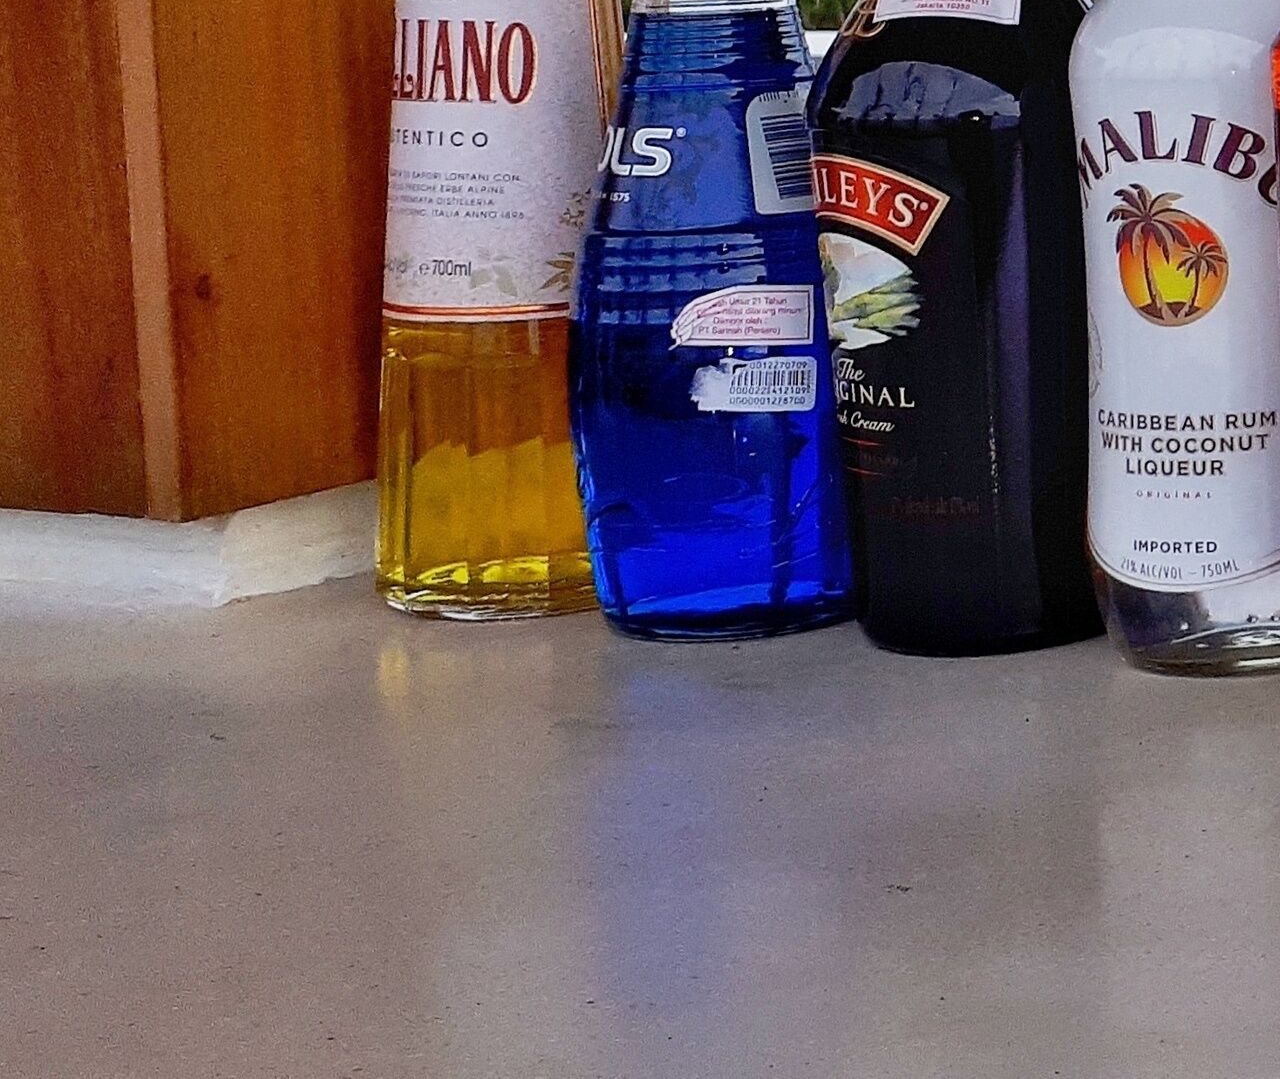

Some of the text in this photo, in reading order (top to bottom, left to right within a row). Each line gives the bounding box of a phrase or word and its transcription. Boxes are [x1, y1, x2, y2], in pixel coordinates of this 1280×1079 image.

[394, 19, 536, 104] LIANO
[836, 358, 866, 382] The
[850, 411, 896, 432] Cream
[1098, 408, 1277, 431] CARIBBEAN RUM
[1101, 431, 1269, 454] WITH COCONUT
[1126, 457, 1225, 476] LIQUEUR
[1133, 539, 1218, 554] IMPORTED
[1201, 558, 1240, 578] 750ML
